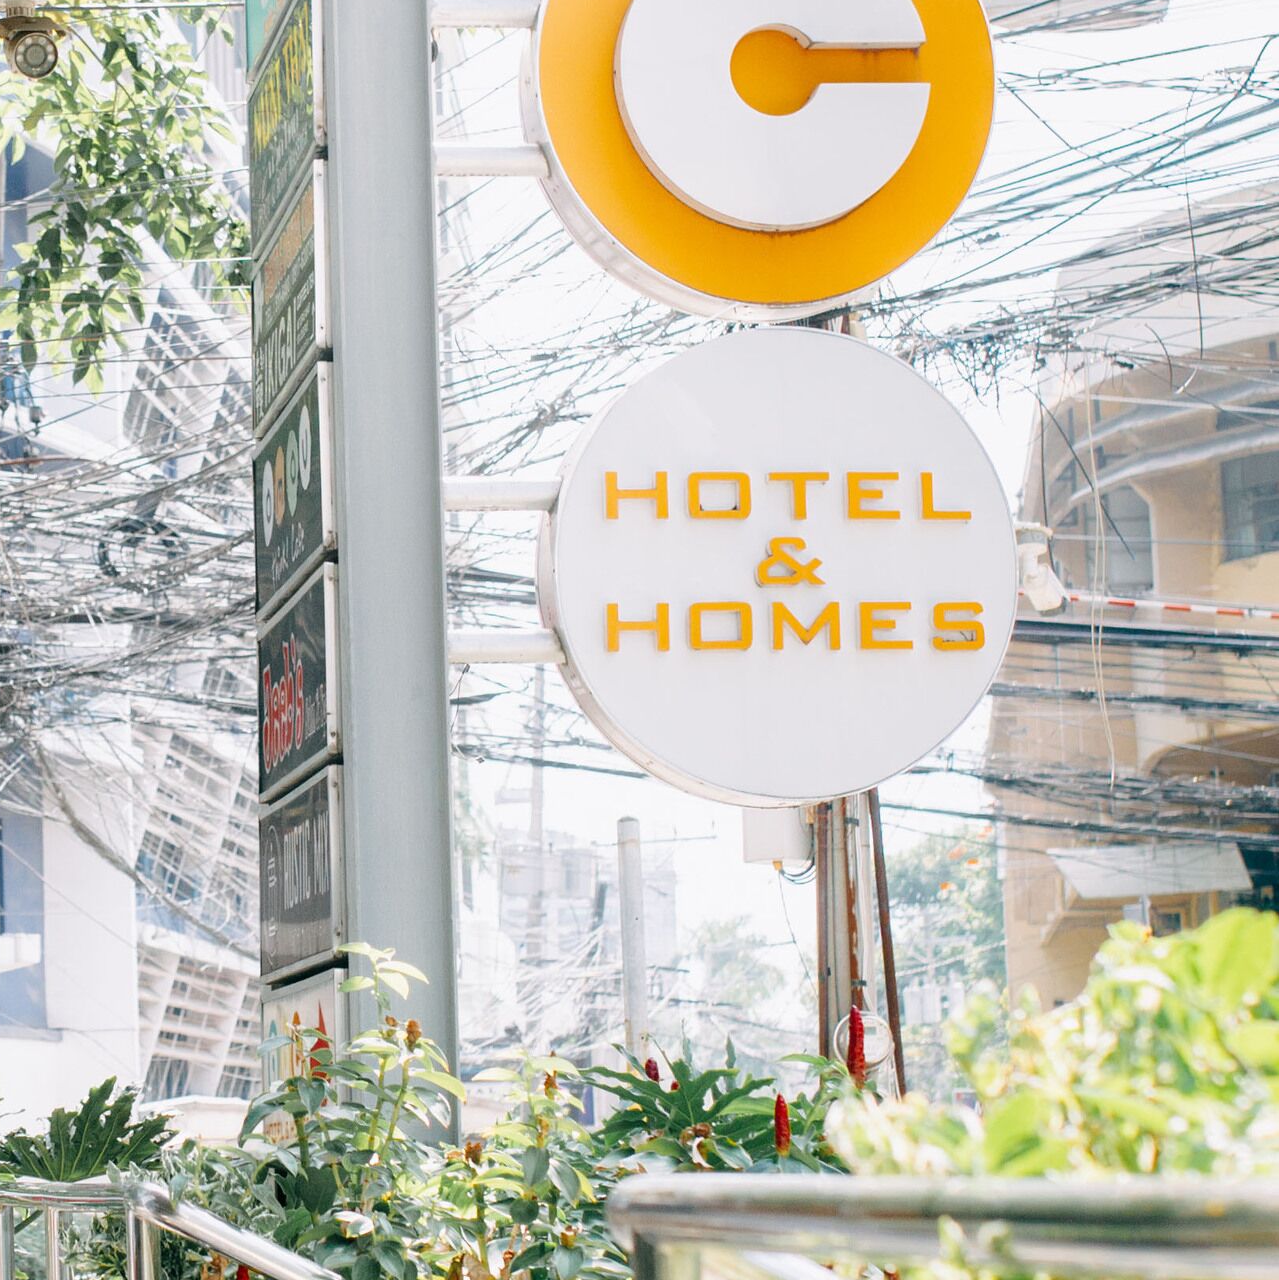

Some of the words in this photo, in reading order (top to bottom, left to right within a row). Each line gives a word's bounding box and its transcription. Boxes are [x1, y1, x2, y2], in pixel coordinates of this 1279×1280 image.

[264, 296, 297, 406] IKIGAI
[604, 470, 972, 521] HOTEL
[755, 536, 826, 586] &
[605, 601, 986, 652] HOMES
[283, 819, 311, 910] RUSTIC
[313, 810, 329, 895] MIX
